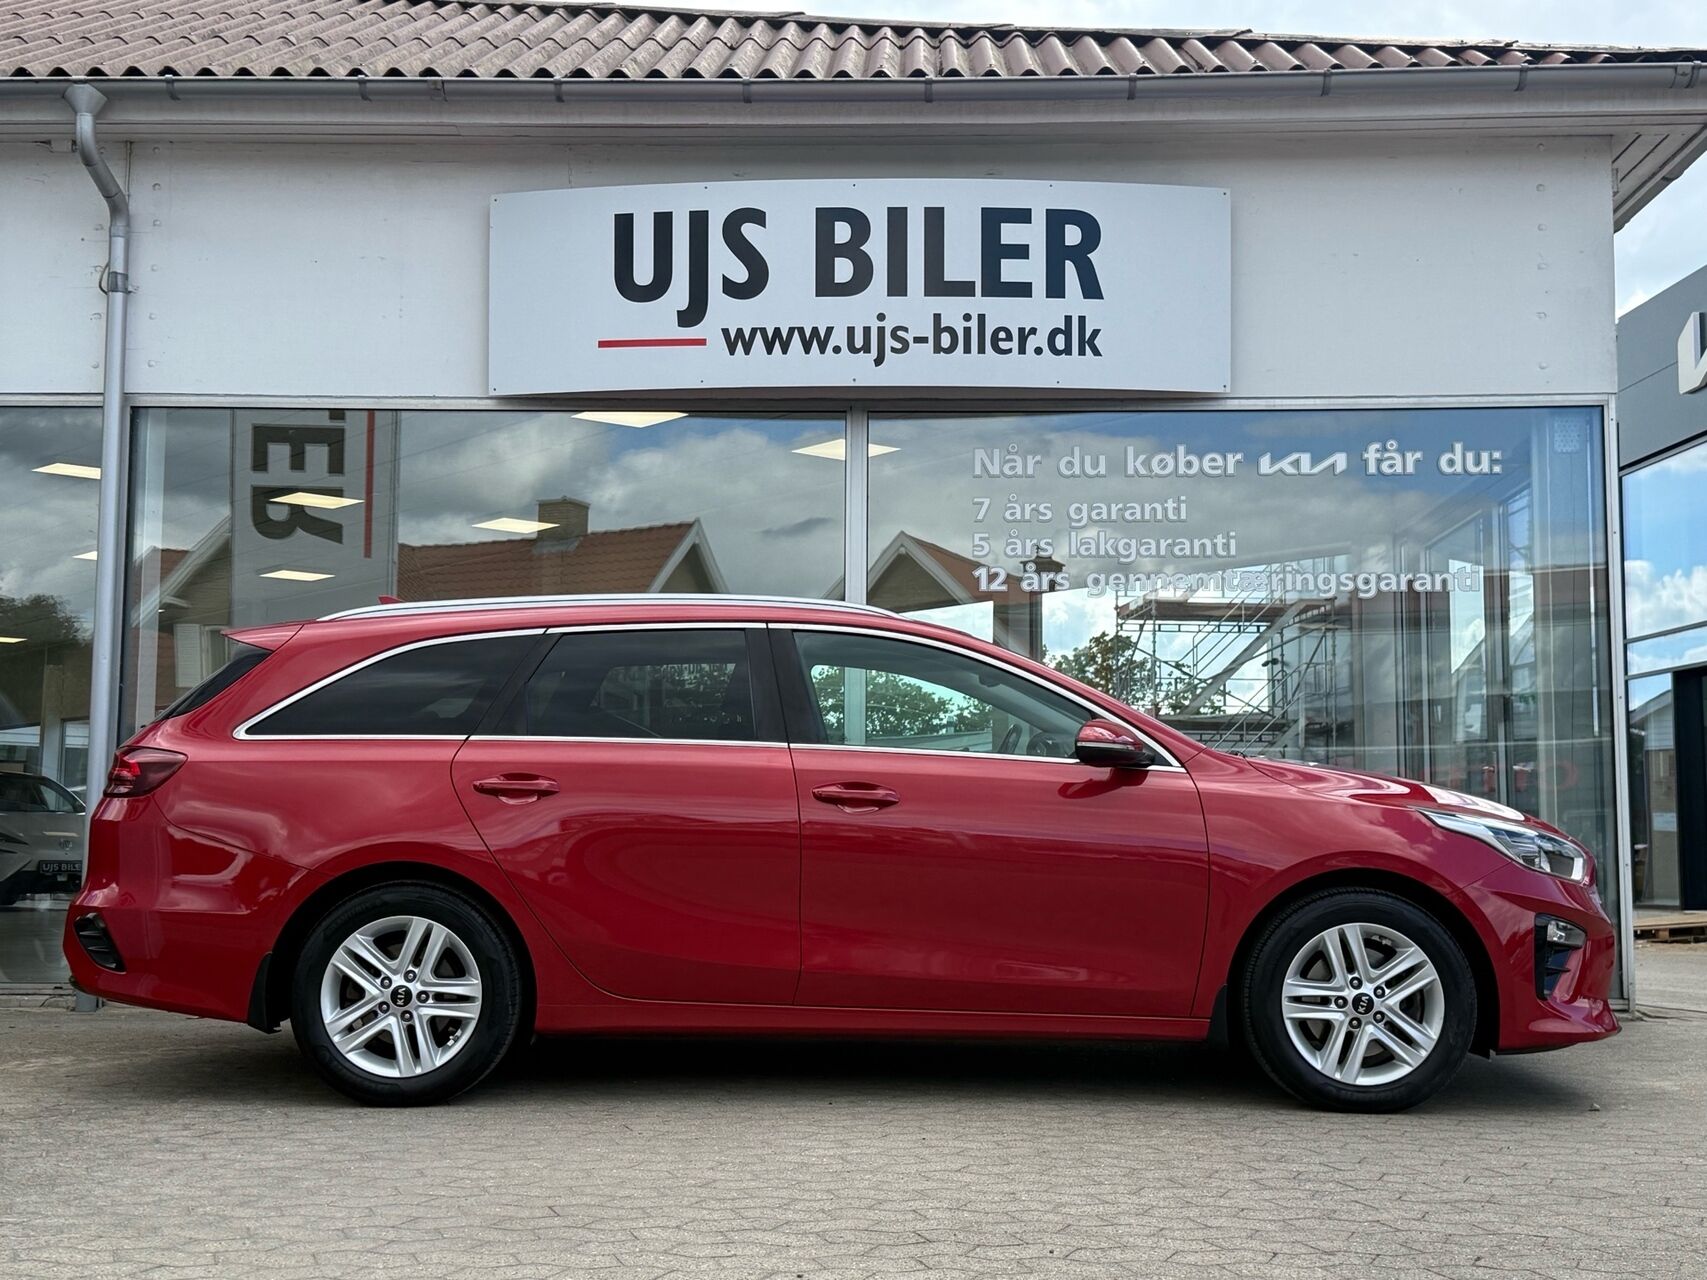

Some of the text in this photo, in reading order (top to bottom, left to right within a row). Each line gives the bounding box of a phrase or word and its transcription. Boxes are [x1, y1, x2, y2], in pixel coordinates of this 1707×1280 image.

[613, 206, 1105, 328] UJS BILER
[720, 312, 1103, 368] www.ujs-biler.dk
[973, 439, 1503, 478] Når du køber KIA får du:
[972, 493, 1188, 529] 7 års garanti
[972, 528, 1237, 565] 5 års lakgaranti
[971, 561, 1482, 599] 12 års gennemtæringsgaranti
[61, 863, 82, 872] BILE
[396, 987, 407, 1006] KIA
[1357, 996, 1370, 1014] KIA
